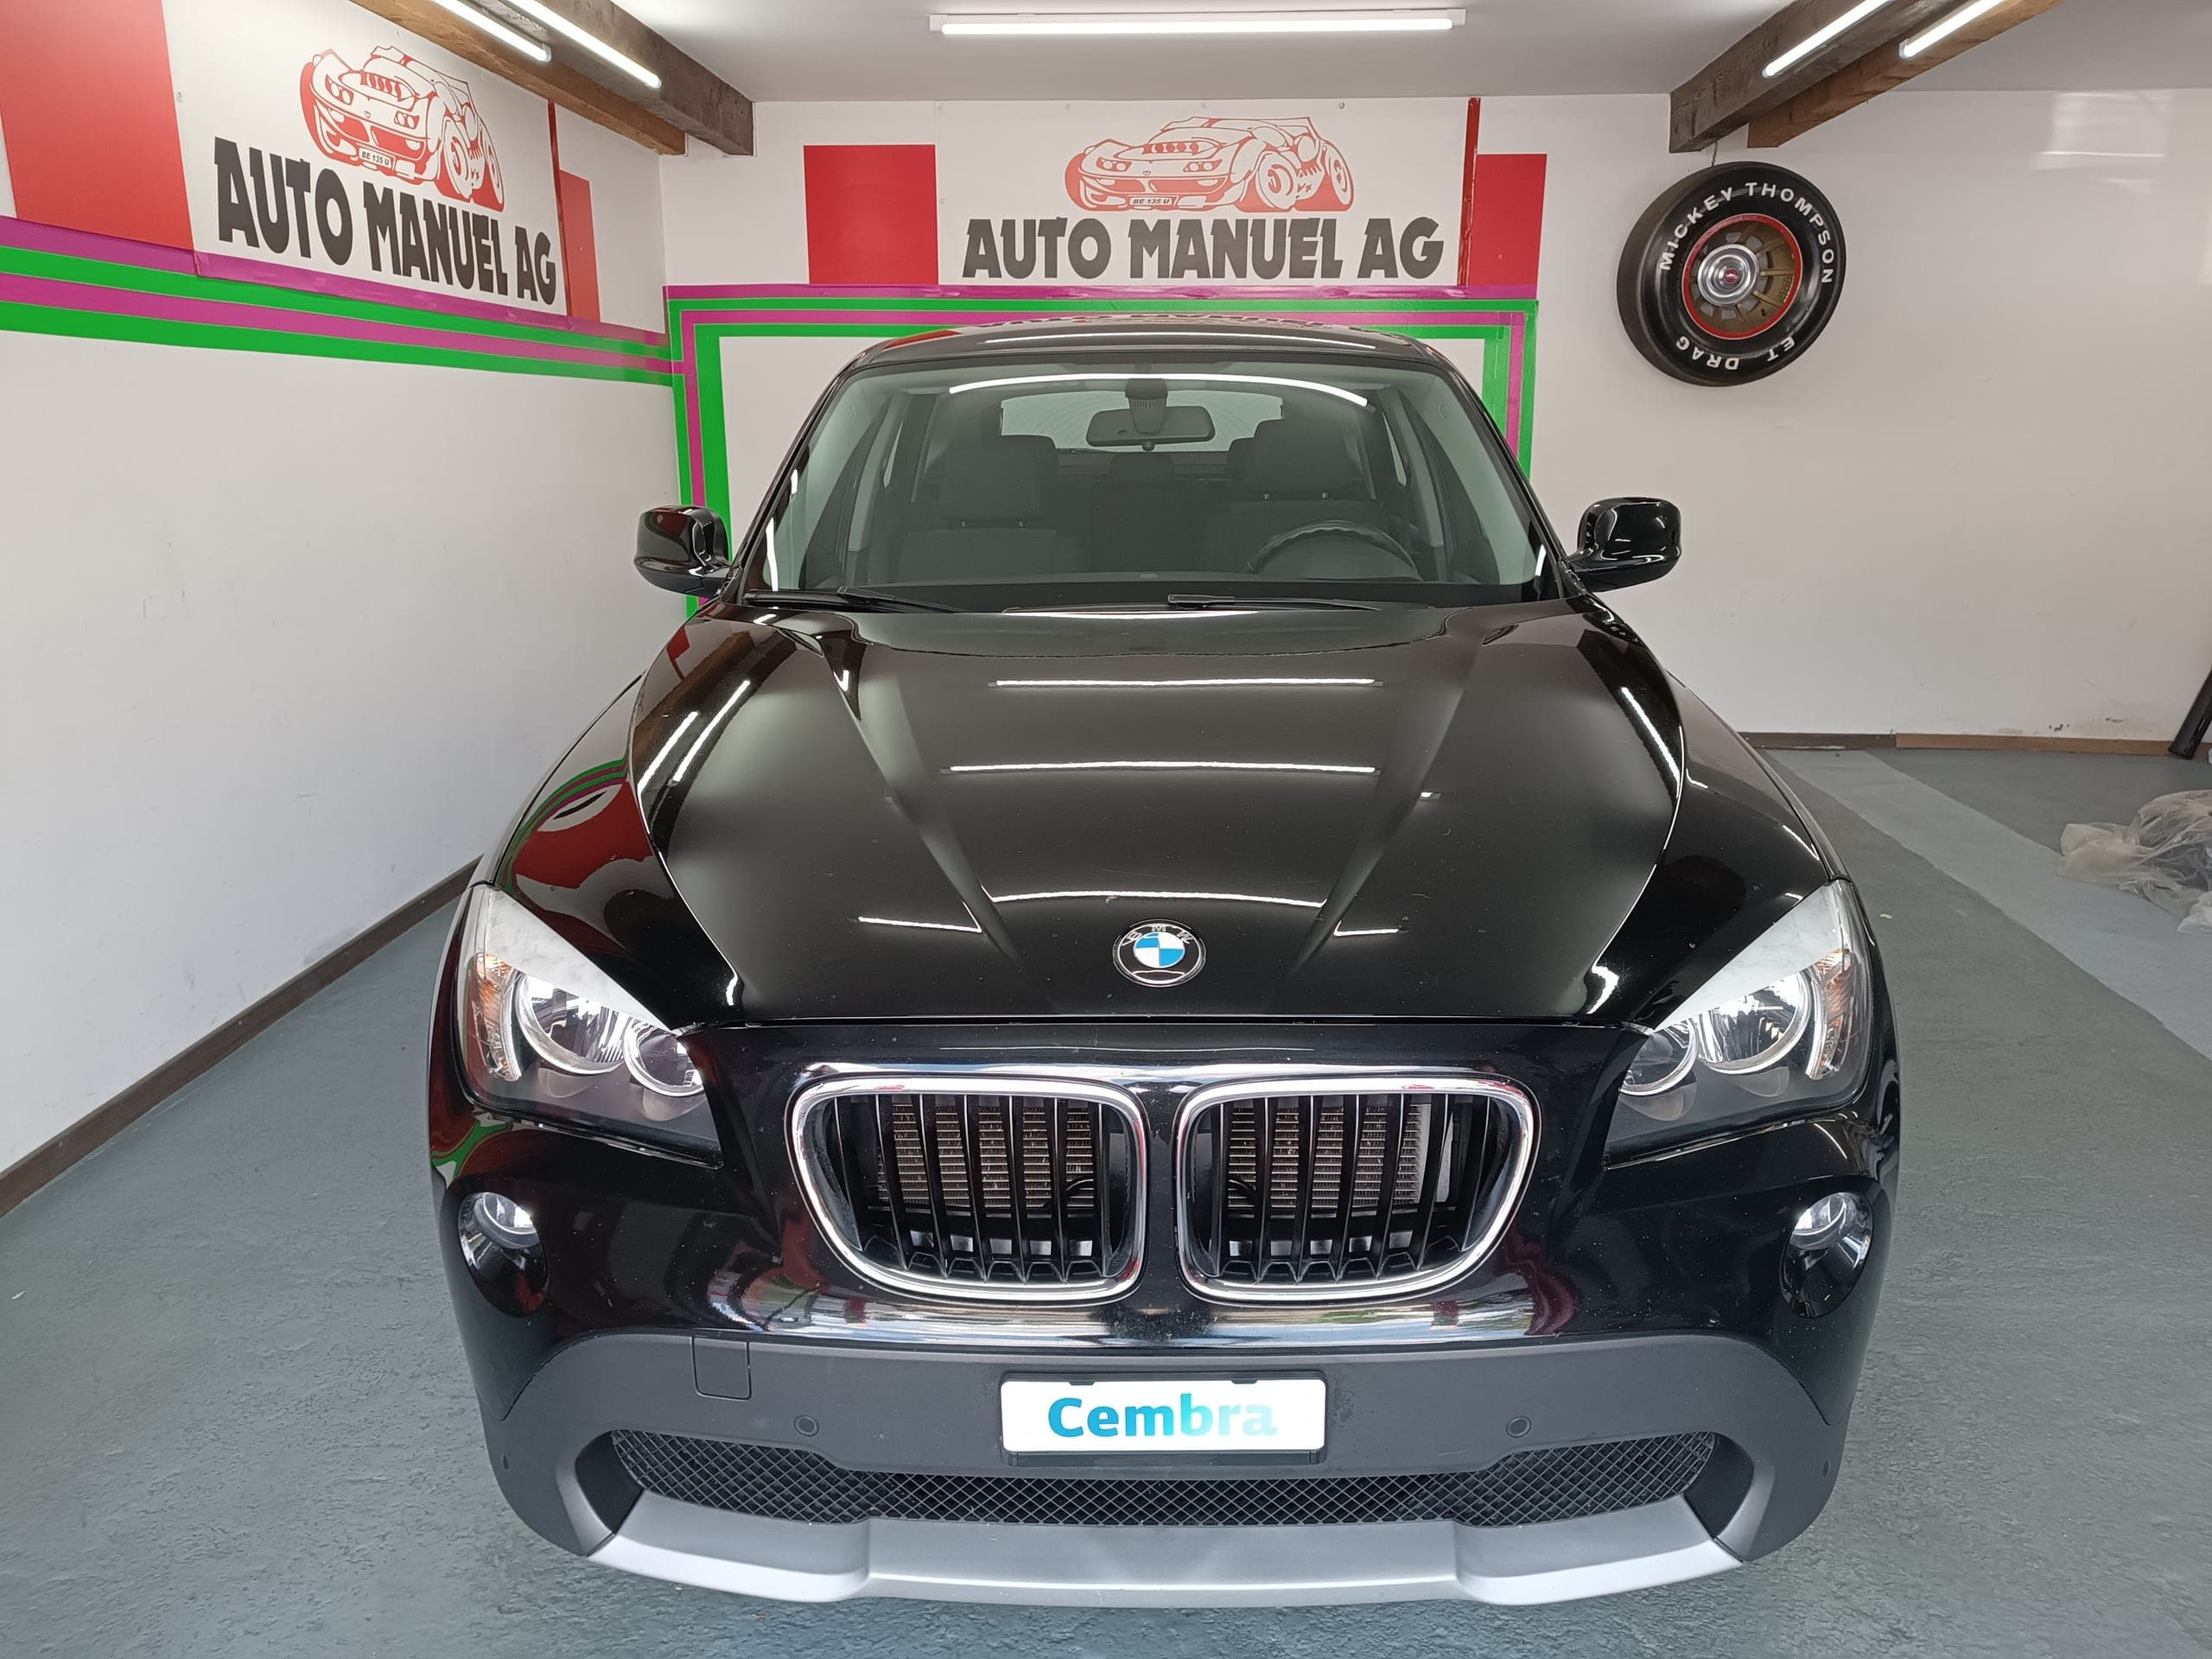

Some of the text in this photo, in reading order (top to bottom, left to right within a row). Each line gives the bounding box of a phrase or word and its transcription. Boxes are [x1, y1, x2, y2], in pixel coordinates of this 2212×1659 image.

[361, 150, 372, 160] BE
[372, 154, 384, 164] 135
[214, 137, 556, 306] AUTO MANUEL AG
[1658, 181, 1834, 283] MICKEY THOMPSON
[962, 216, 1445, 280] AUTO MANUEL AG
[1675, 335, 1740, 371] DRAG
[1126, 925, 1193, 944] BMW
[1048, 1393, 1278, 1438] Cembra
